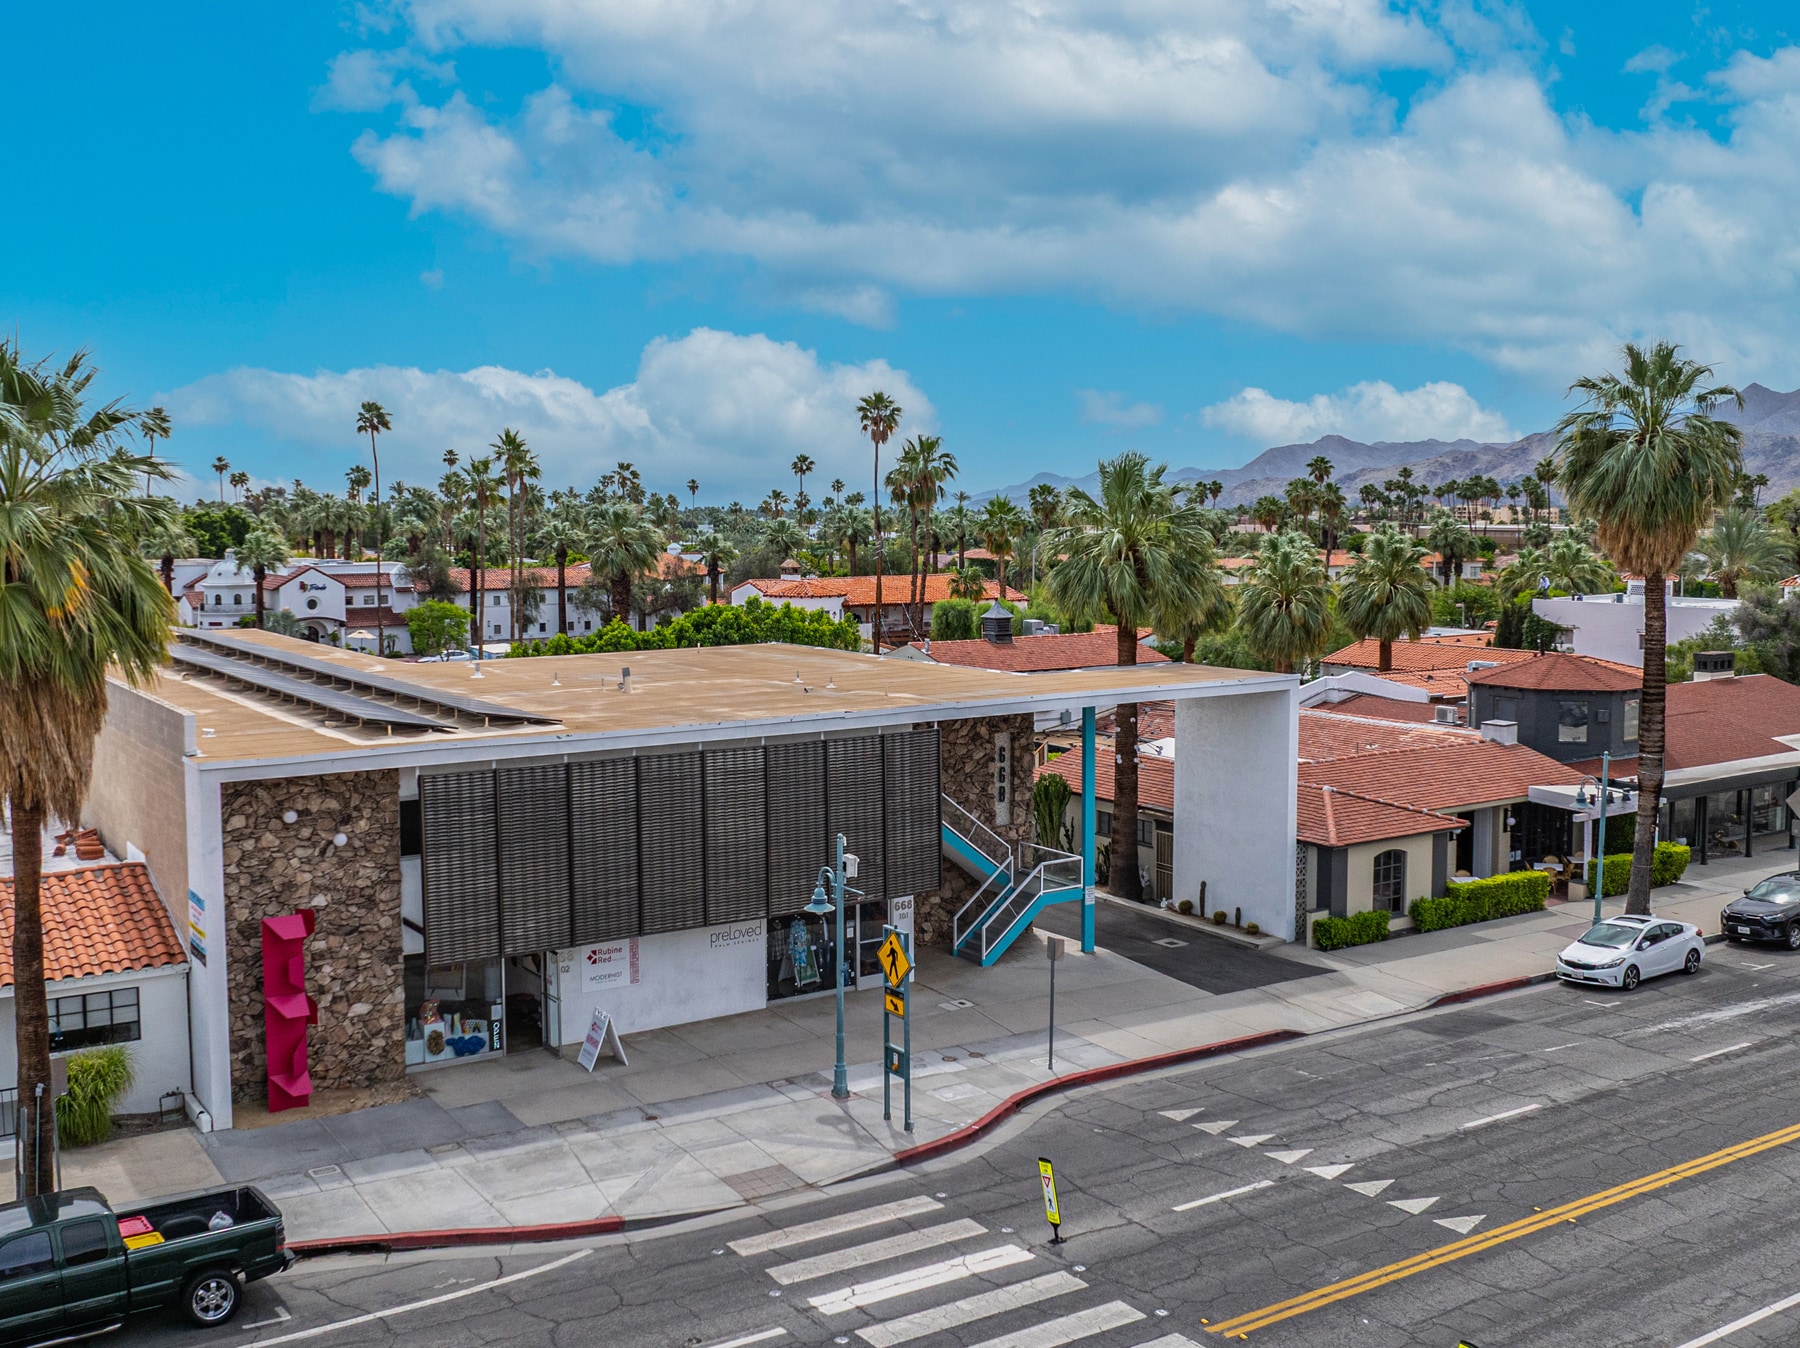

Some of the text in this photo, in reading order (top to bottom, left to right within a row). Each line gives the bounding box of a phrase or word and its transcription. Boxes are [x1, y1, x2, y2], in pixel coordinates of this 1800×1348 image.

[895, 899, 913, 911] 668
[899, 911, 909, 920] 101
[710, 920, 762, 949] preLoved
[597, 946, 623, 956] Rubine
[597, 955, 612, 964] Red
[589, 971, 623, 982] MODERNIST
[493, 1021, 501, 1050] OPEN
